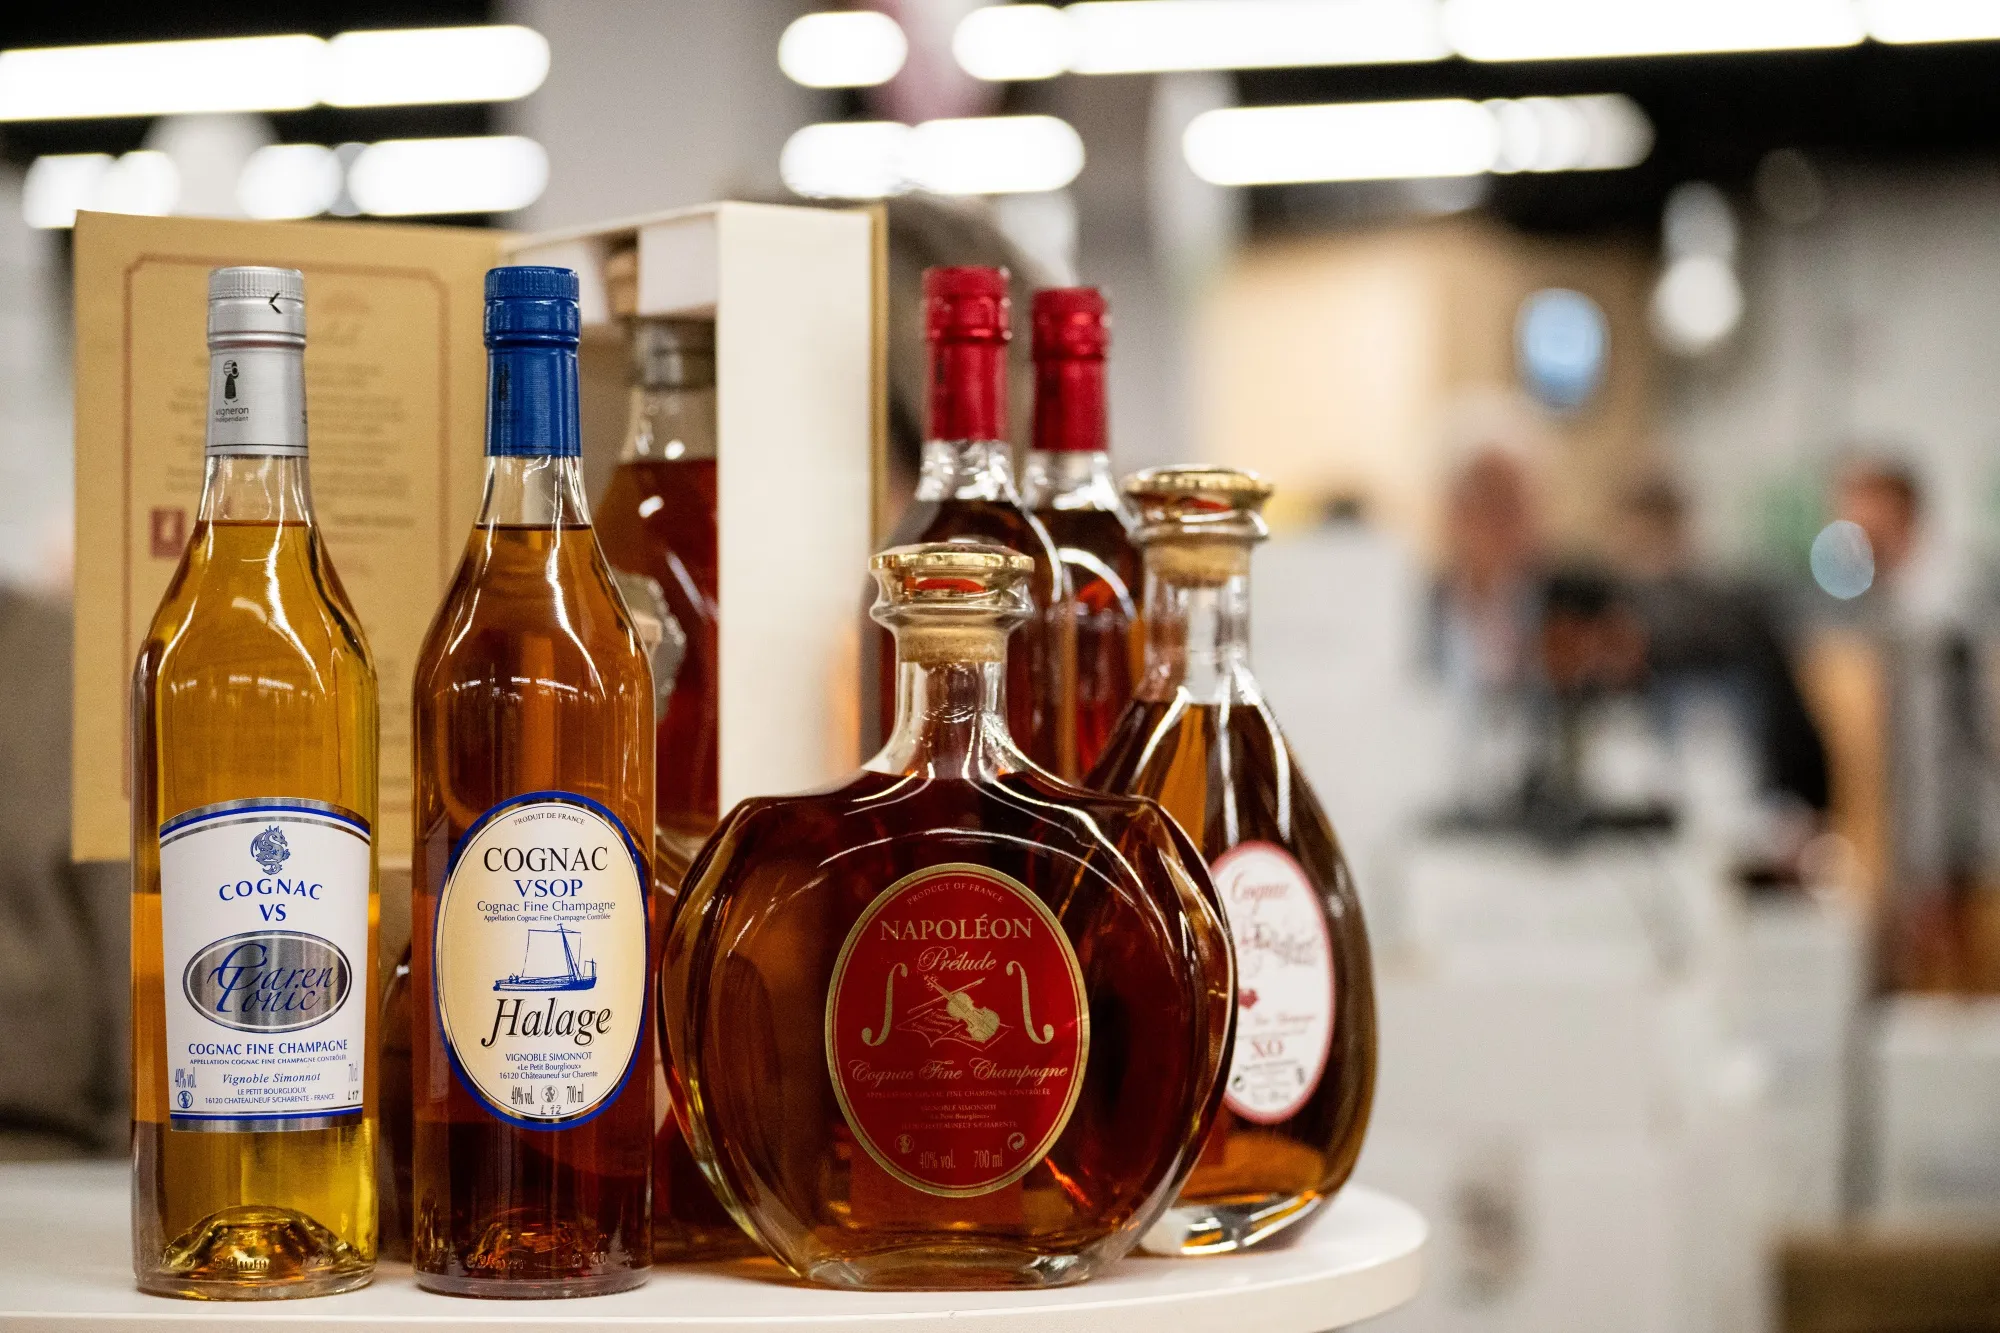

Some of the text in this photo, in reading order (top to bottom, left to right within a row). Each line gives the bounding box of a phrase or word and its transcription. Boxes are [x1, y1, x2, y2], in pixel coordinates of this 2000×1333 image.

[215, 408, 249, 416] vigneron
[514, 812, 545, 826] PRODUIT
[558, 813, 586, 825] FRANCE
[484, 846, 608, 872] COGNAC
[219, 878, 322, 900] COGNAC
[514, 879, 583, 898] VSOP
[906, 882, 950, 905] PRODUCT
[970, 883, 1004, 903] FRANCE
[259, 904, 286, 922] VS
[477, 900, 616, 914] Cognac Fine Champagne
[553, 914, 586, 922] Champagne
[880, 914, 1032, 940] NAPOLÉON
[217, 943, 338, 990] Caren
[916, 946, 997, 972] Prélude
[481, 997, 612, 1048] Halage
[188, 1039, 348, 1055] COGNAC FINE CHAMPAGNE
[506, 1052, 592, 1062] VIGNOBLE SIMONNOT
[174, 1068, 186, 1088] 40%
[222, 1073, 321, 1086] Vignoble Simonnot
[520, 1071, 560, 1080] Châteauneuf
[848, 1057, 1068, 1088] Cognac Fine Champagne
[264, 1087, 306, 1095] BOURGLIOUX
[272, 1095, 310, 1104] S/CHARENTE
[511, 1086, 524, 1105] 40%
[566, 1084, 584, 1104] 700 ml
[920, 1150, 956, 1169] 40% vol.
[974, 1148, 1003, 1168] 700 ml
